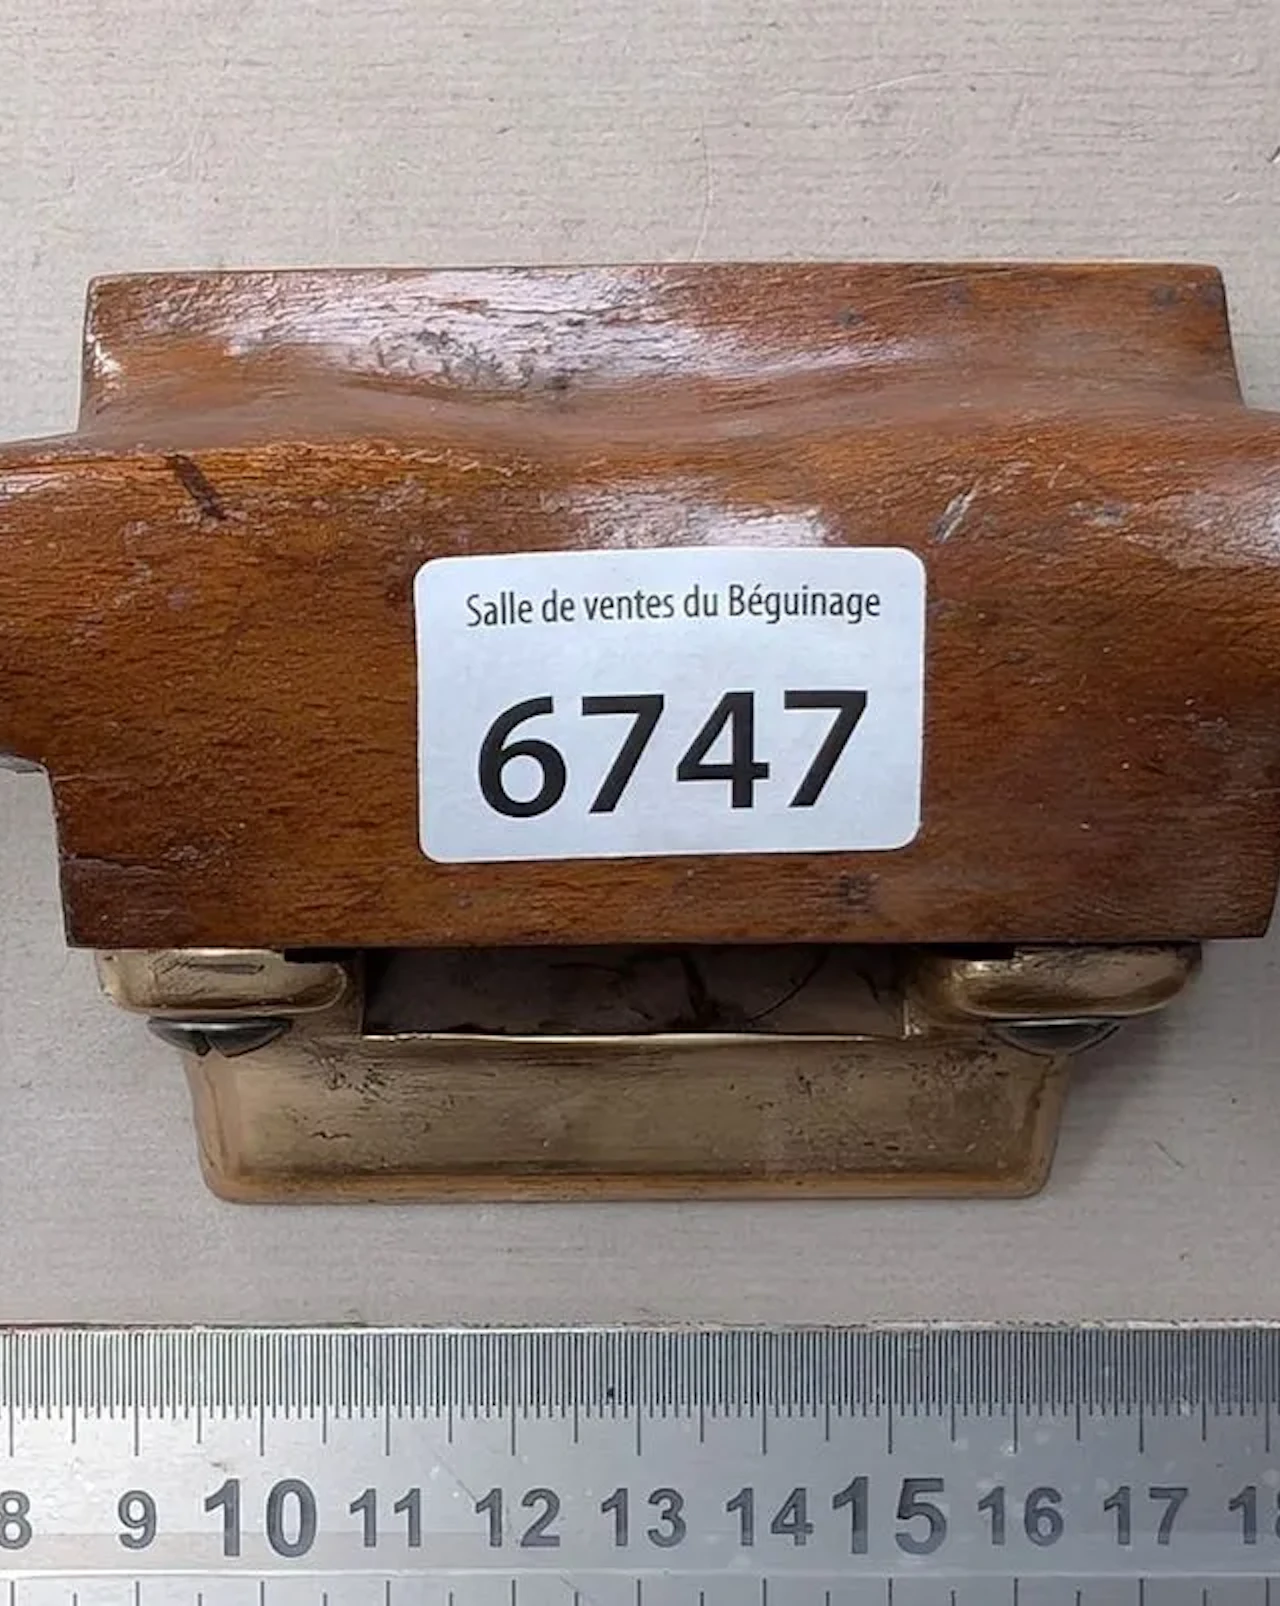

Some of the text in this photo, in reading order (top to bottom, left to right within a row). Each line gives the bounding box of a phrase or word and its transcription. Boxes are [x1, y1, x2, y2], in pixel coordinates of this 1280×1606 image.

[466, 584, 881, 627] Salle de ventes du Béguinage
[477, 689, 869, 818] 6747
[118, 1490, 157, 1550] 9
[204, 1479, 316, 1558] 10
[350, 1489, 421, 1549] 11
[475, 1489, 560, 1549] 12
[601, 1489, 686, 1548] 13
[726, 1488, 813, 1548] 14
[833, 1478, 946, 1557] 15
[978, 1488, 1063, 1547] 16
[1104, 1487, 1188, 1547] 17
